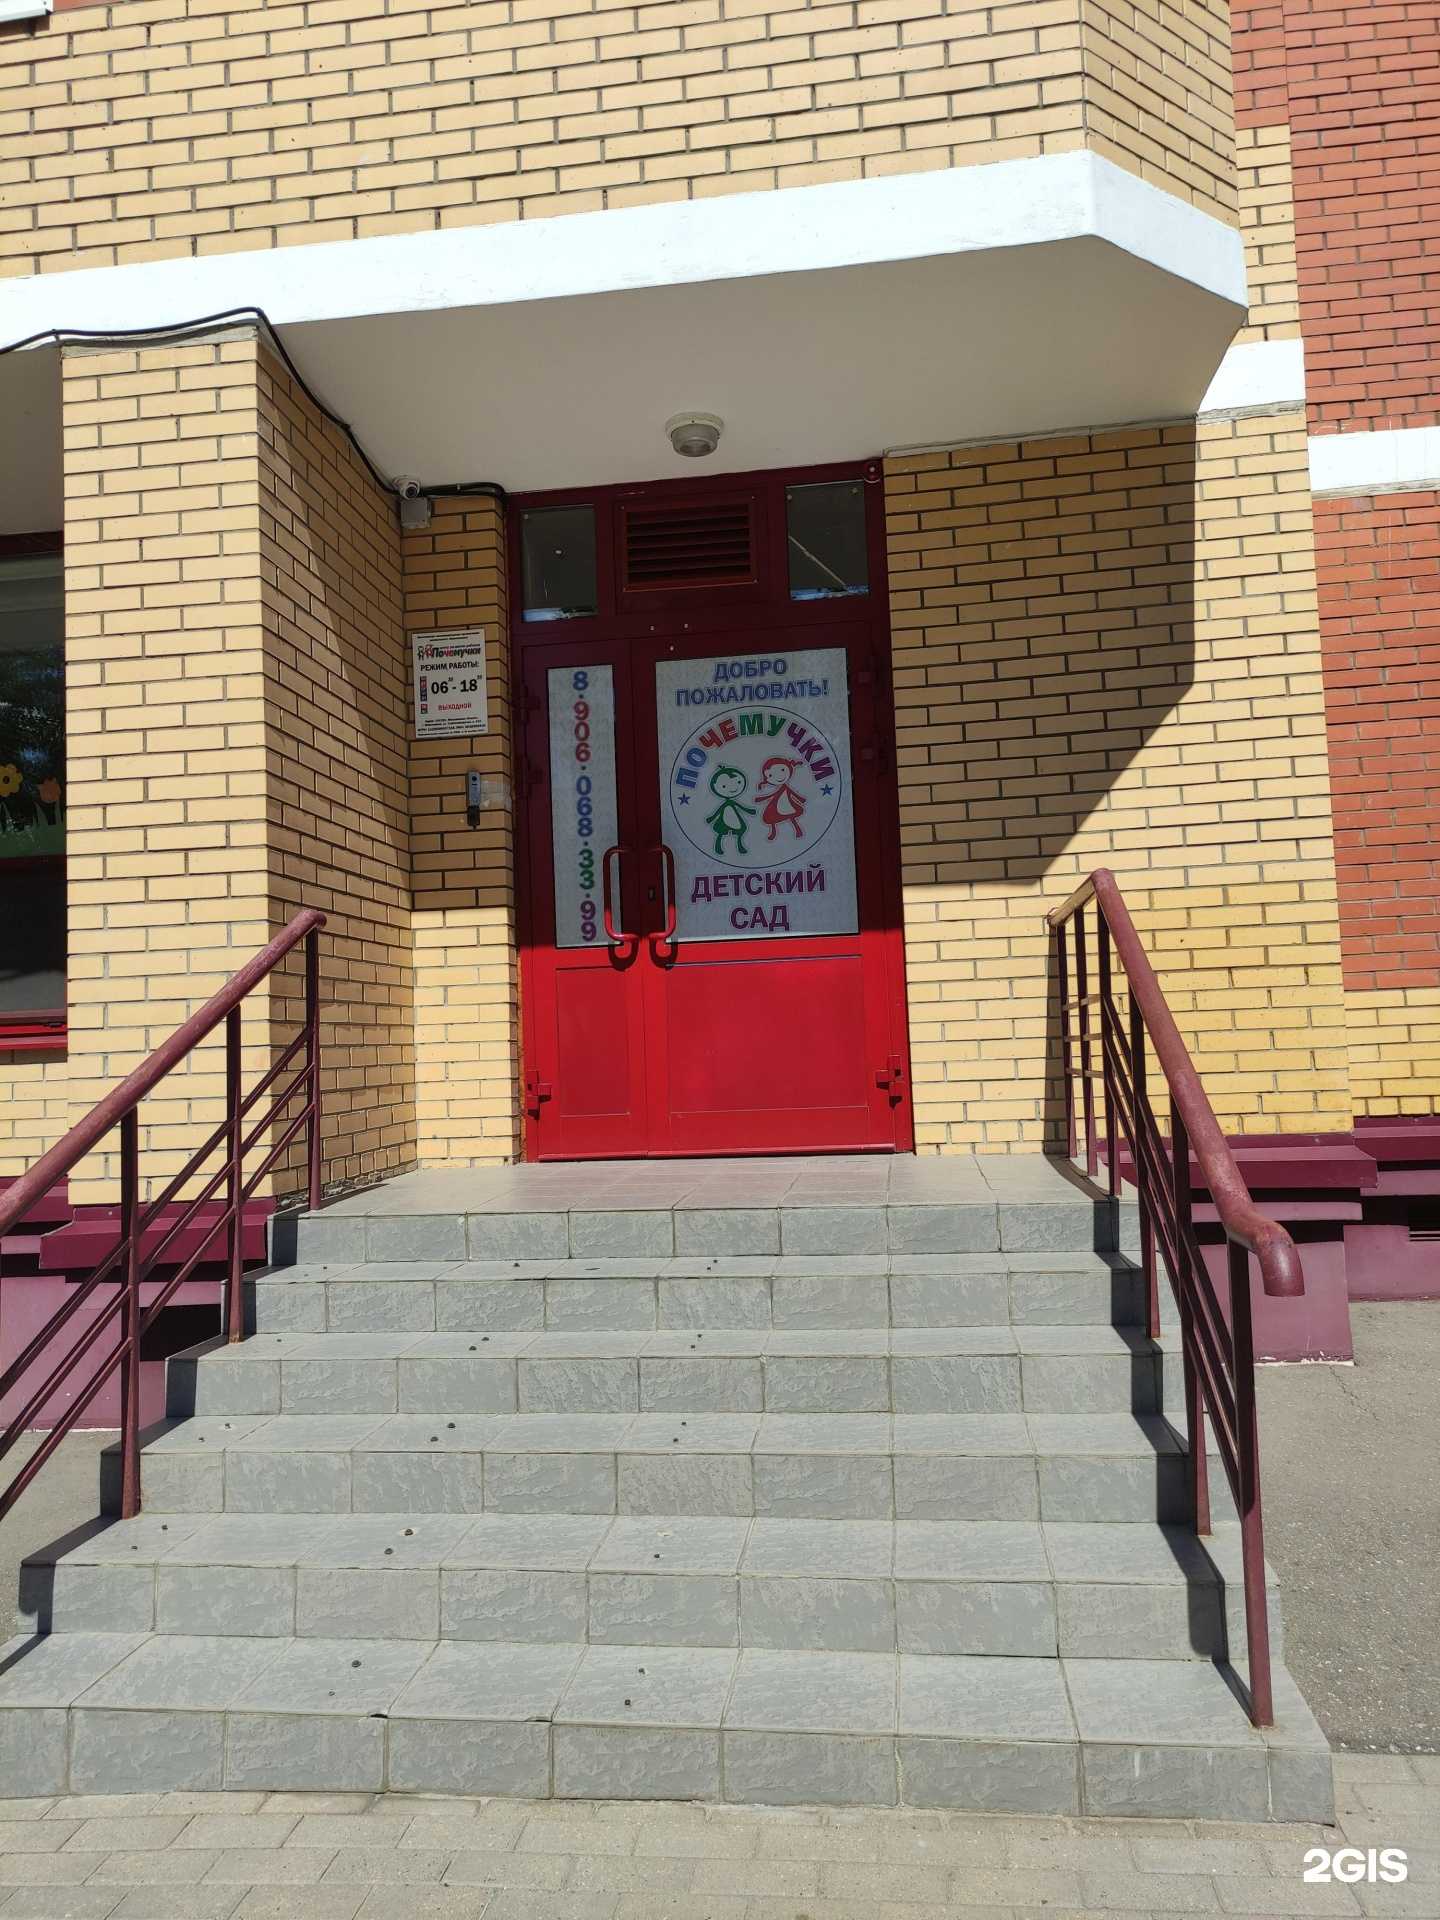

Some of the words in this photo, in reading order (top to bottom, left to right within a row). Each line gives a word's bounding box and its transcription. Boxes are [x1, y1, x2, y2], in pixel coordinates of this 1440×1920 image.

[420, 662, 448, 672] РЕЖИМ
[448, 660, 480, 670] РАБОТЫ:
[713, 658, 788, 682] ДОБРО
[675, 678, 829, 707] ПОЖАЛОВАТЬ!
[675, 712, 836, 790] ПОЧЕМУЧКИ
[690, 863, 826, 904] ДЕТСКИЙ
[729, 905, 790, 932] САД
